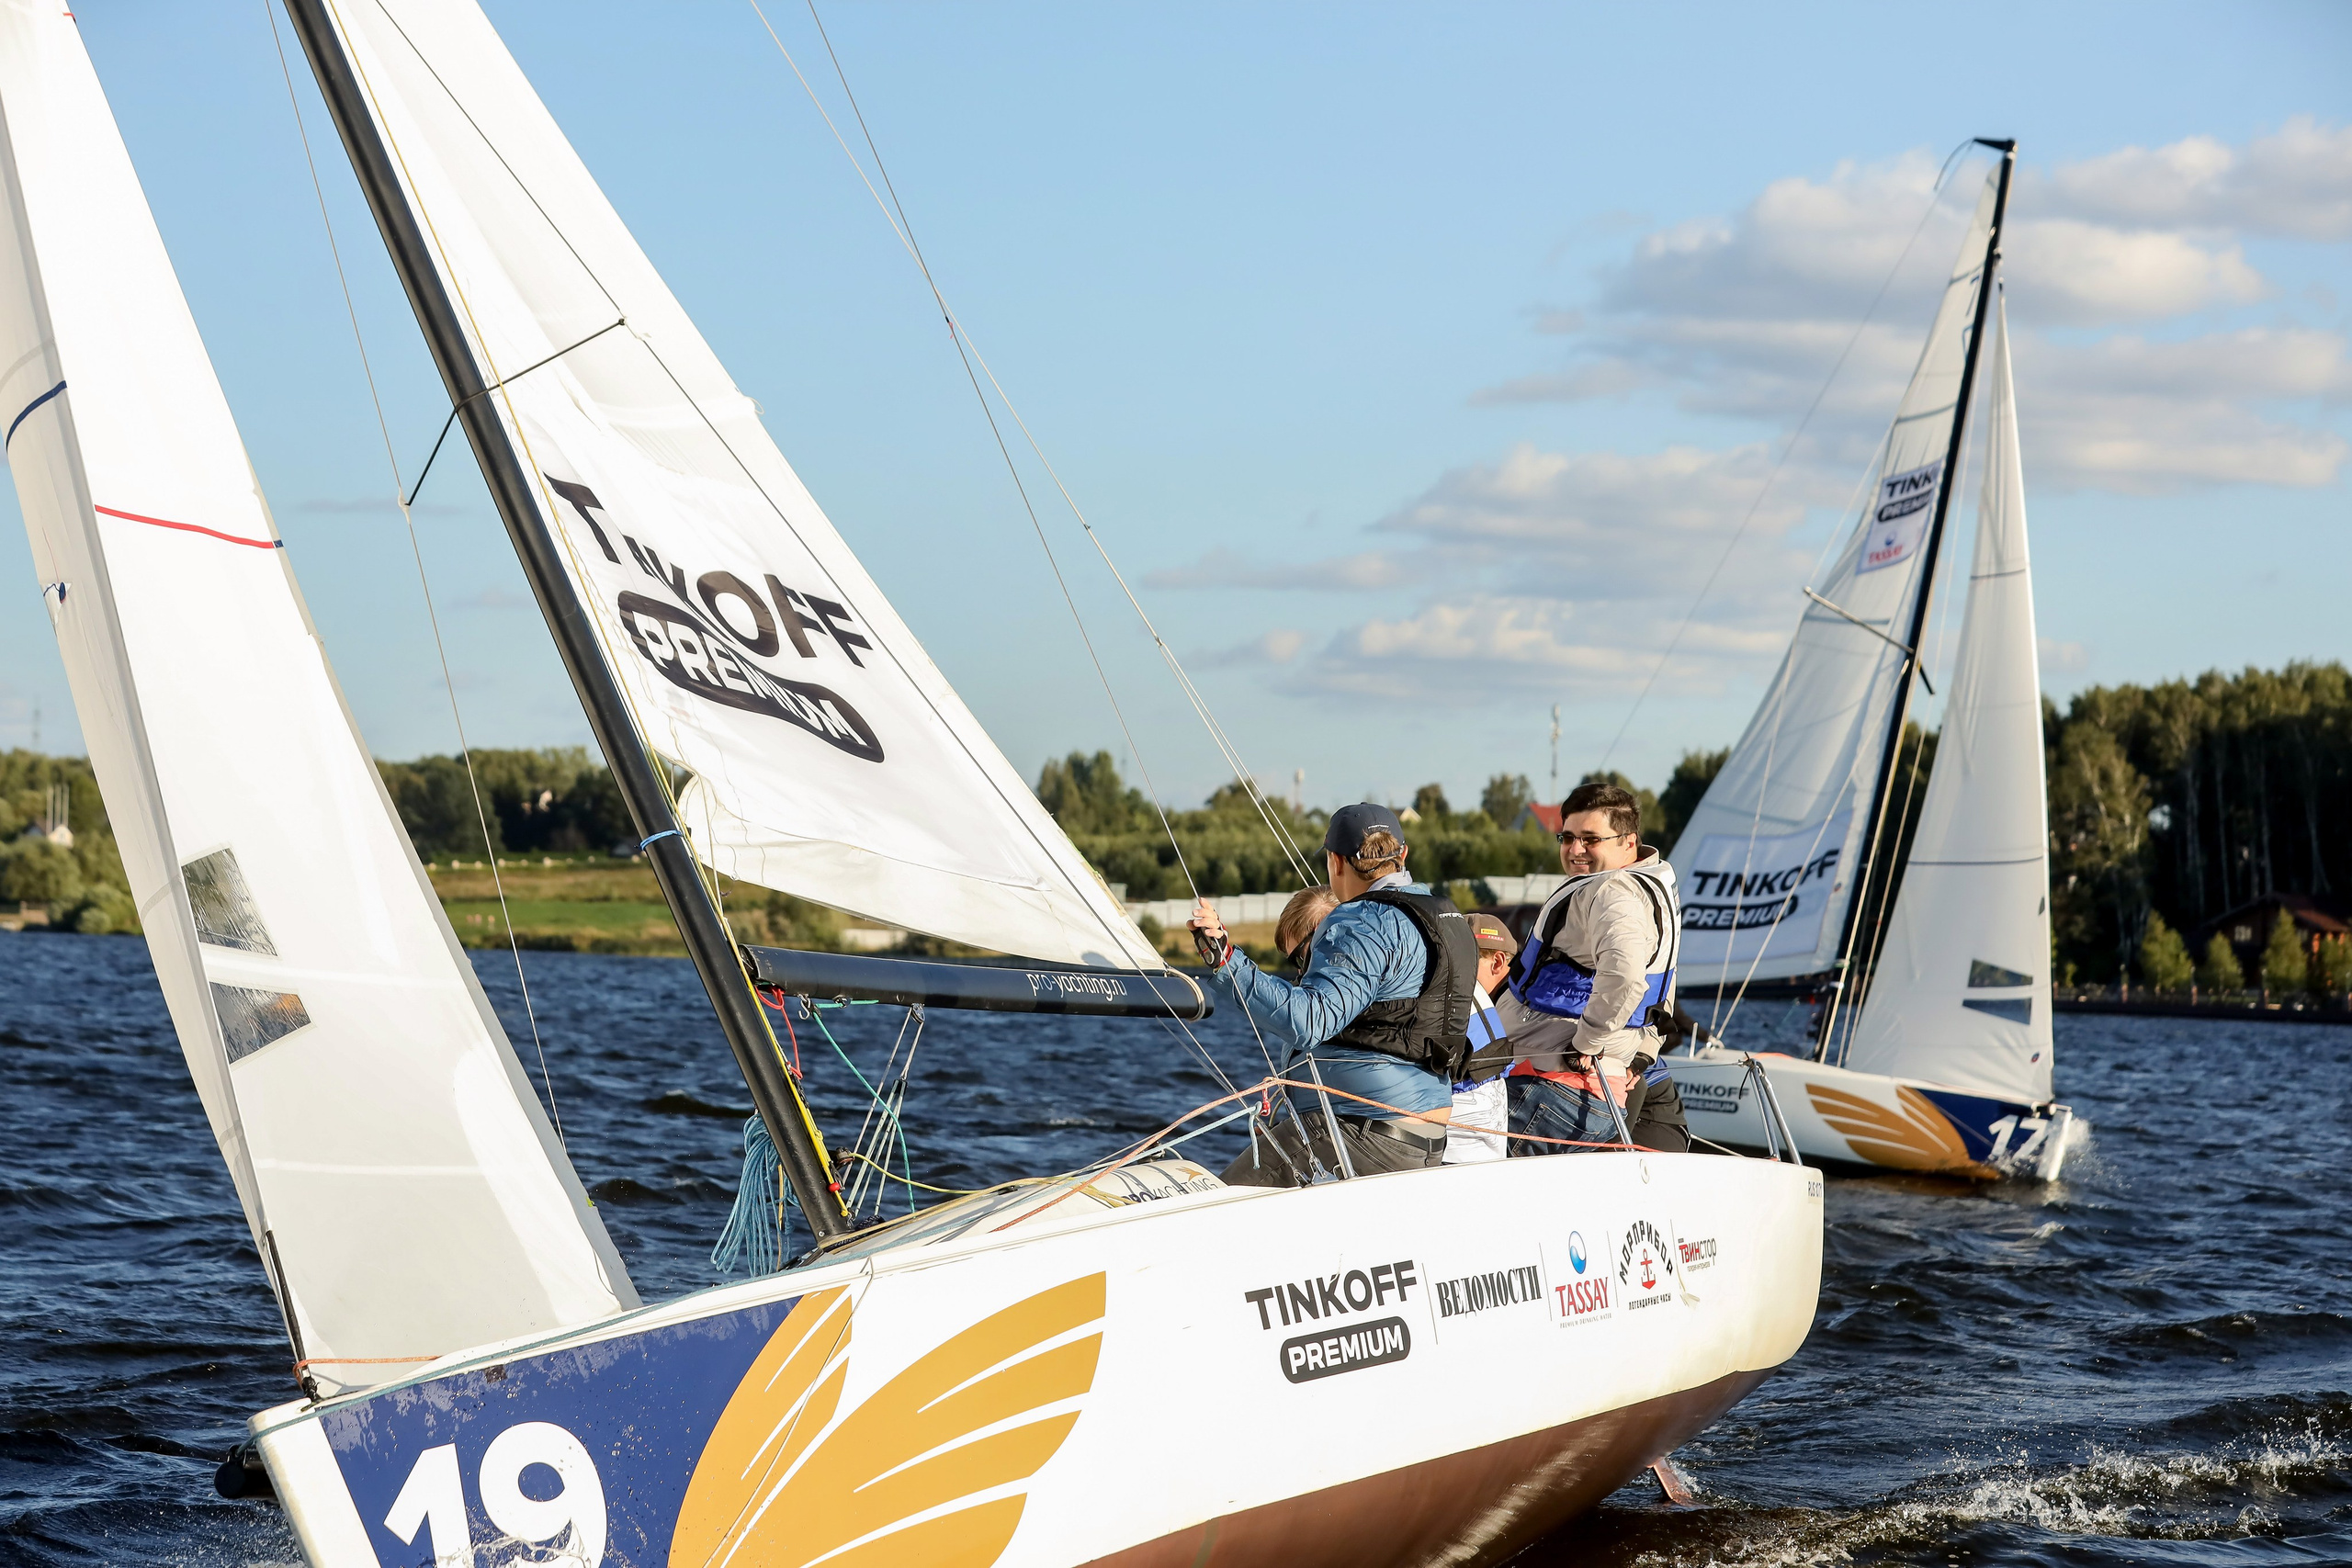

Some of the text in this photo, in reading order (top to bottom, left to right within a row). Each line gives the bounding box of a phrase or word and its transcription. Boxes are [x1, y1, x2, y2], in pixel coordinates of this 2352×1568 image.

[631, 611, 867, 747] PREMIUM
[1693, 849, 1839, 897] TINKOFF
[1026, 973, 1127, 1001] pro-yachting.ru
[1988, 1114, 2048, 1161] 17
[1619, 1220, 1673, 1285] МОРПРИБОР
[1244, 1259, 1418, 1330] TINKOFF
[1435, 1265, 1543, 1319] ВЕДОМОСТИ
[1555, 1277, 1610, 1317] TASSAY
[1287, 1324, 1404, 1375] PREMIUM
[384, 1421, 607, 1568] 19
